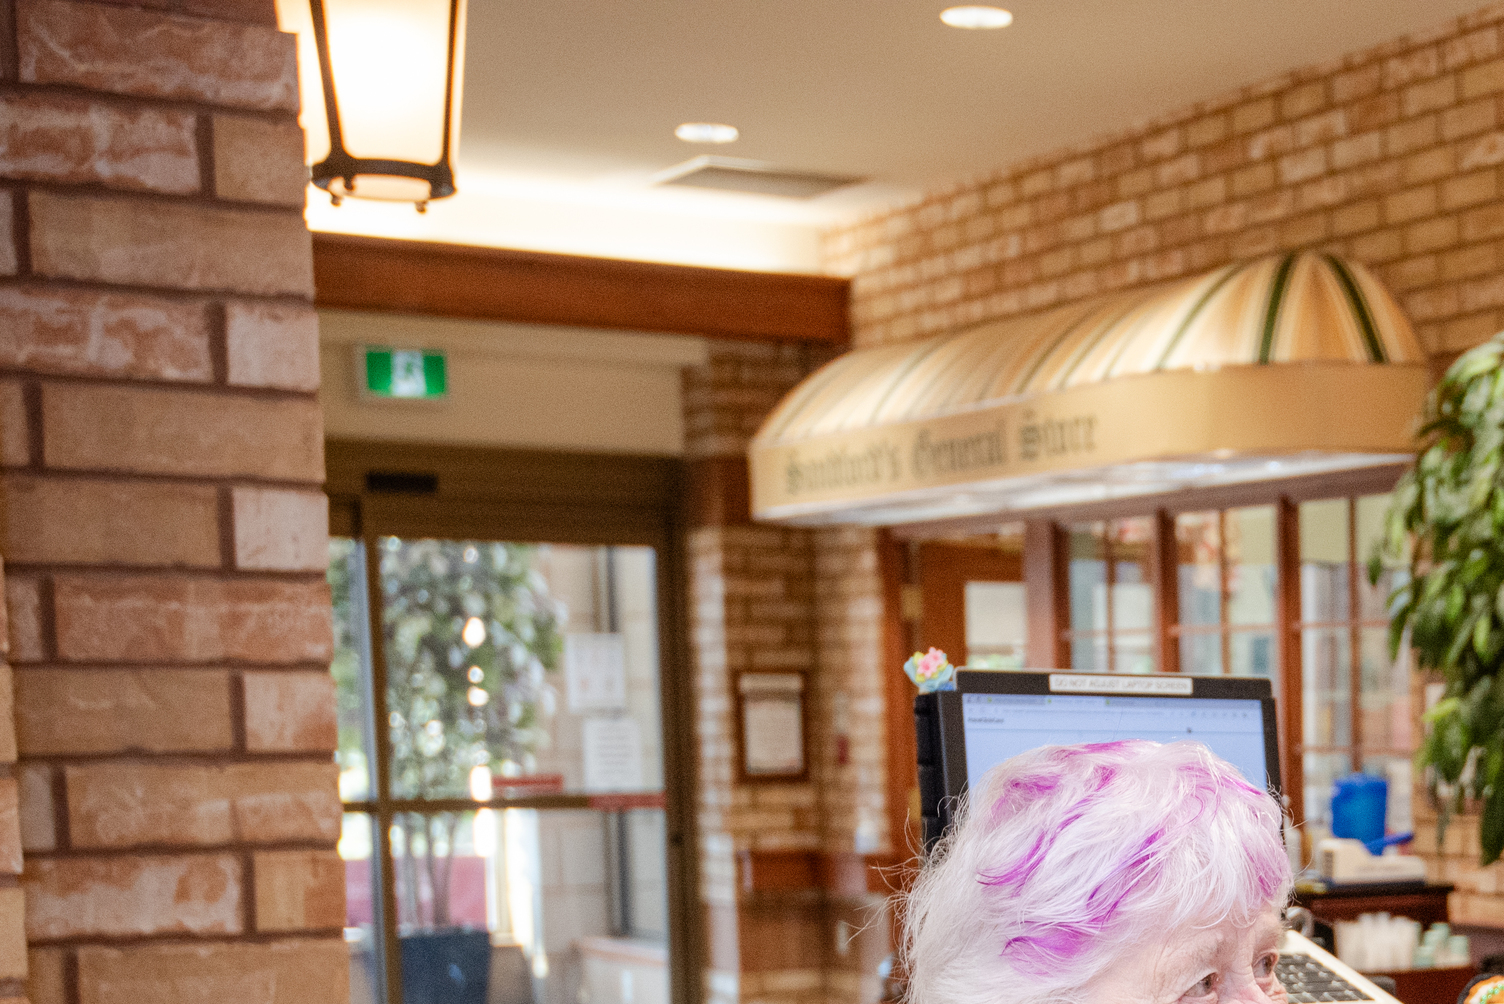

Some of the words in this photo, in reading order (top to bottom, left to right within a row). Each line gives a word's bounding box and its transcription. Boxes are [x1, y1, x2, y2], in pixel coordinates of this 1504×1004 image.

[912, 416, 1006, 481] General
[1020, 407, 1097, 462] Store
[1070, 679, 1087, 687] NOT
[1122, 680, 1152, 689] LAPTOP
